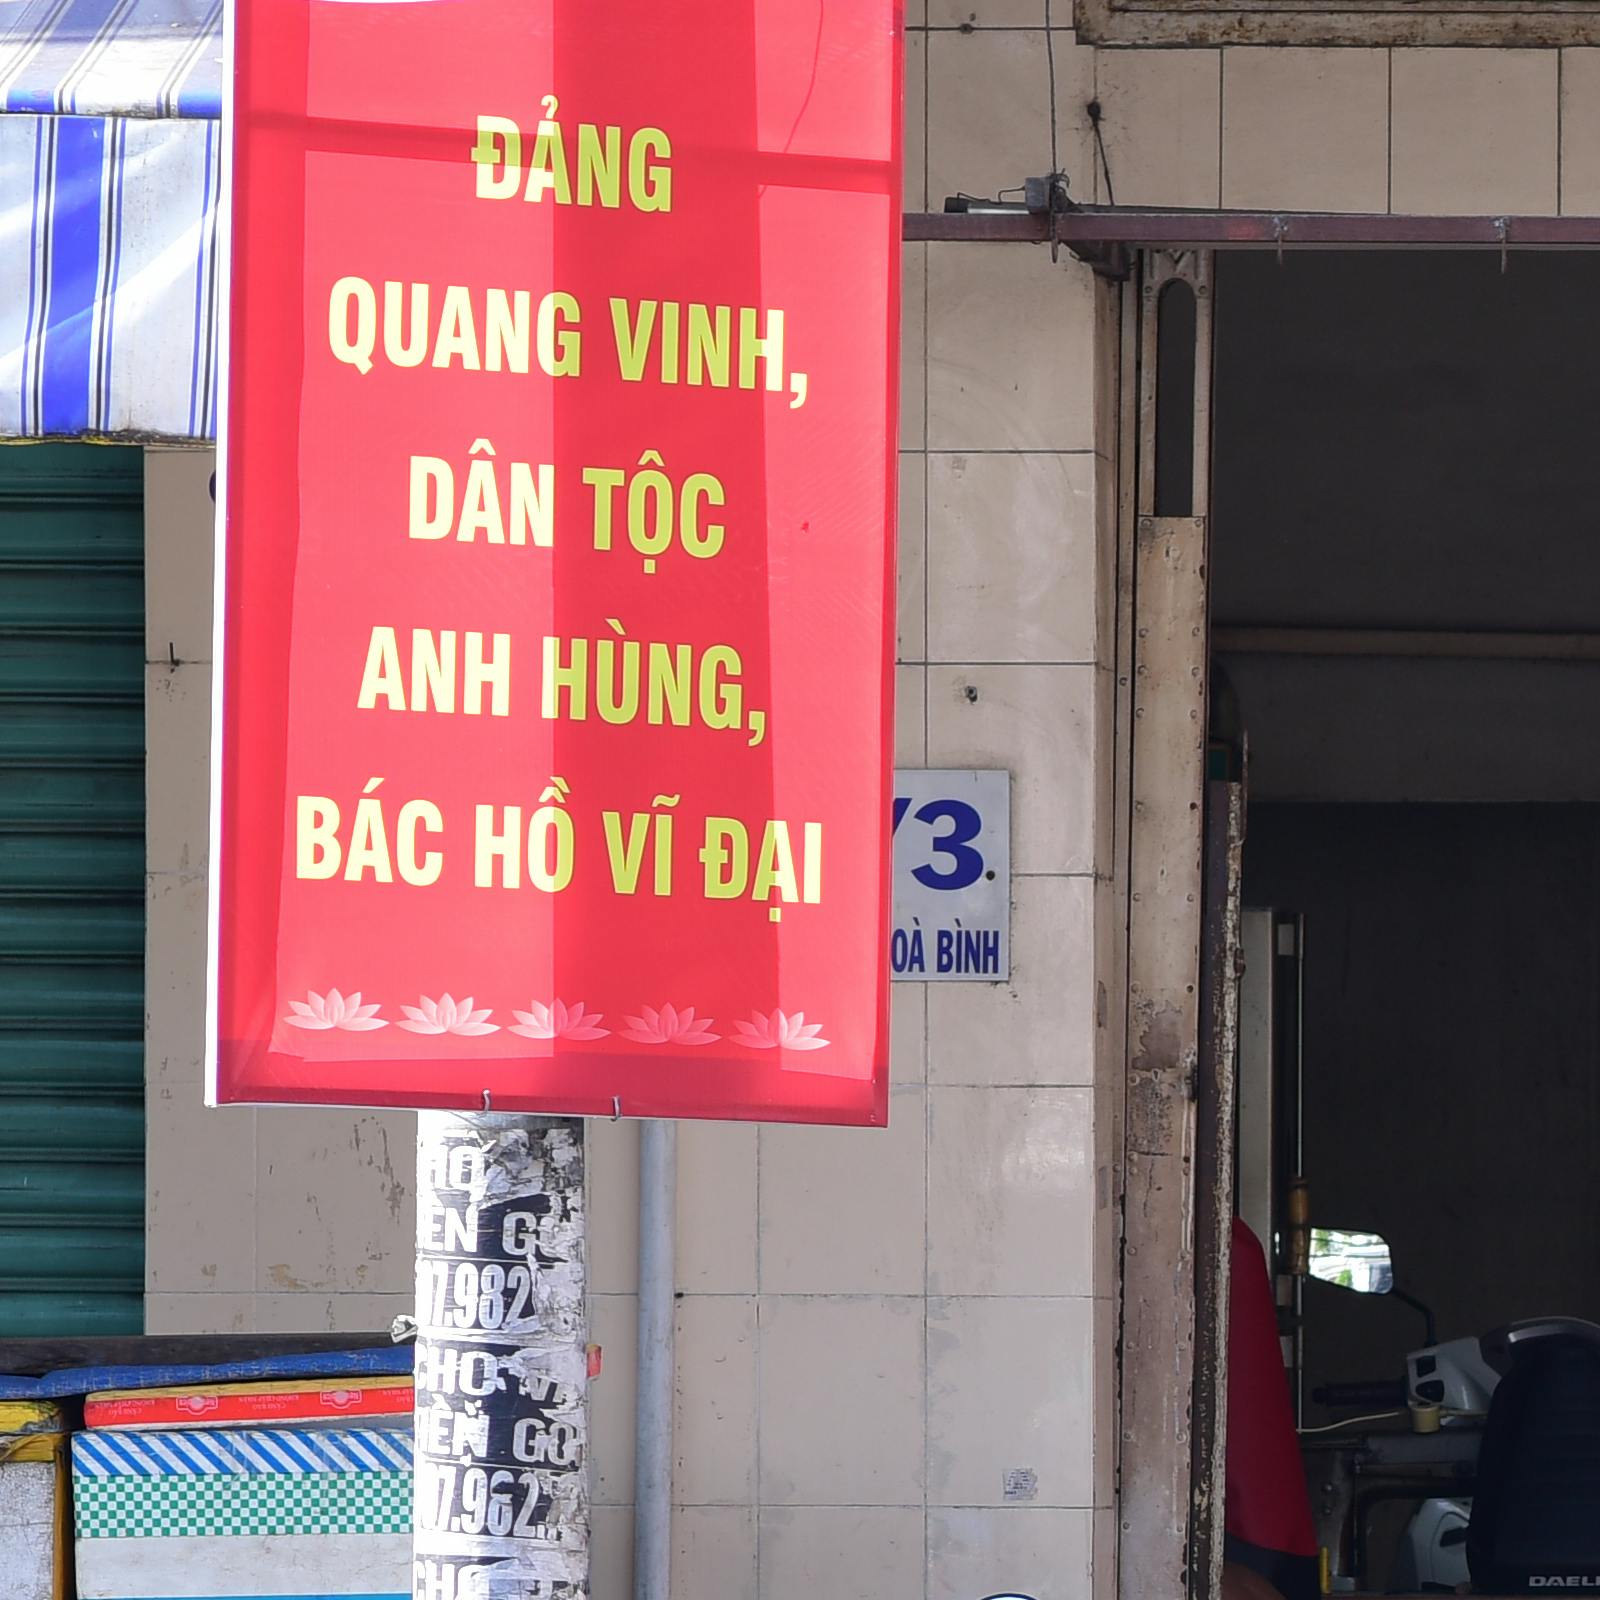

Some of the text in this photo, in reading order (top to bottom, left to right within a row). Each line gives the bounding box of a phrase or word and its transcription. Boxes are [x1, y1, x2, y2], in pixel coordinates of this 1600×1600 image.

[471, 94, 672, 213] ĐẢNG
[328, 276, 809, 410] QUANG VINH,
[409, 437, 727, 574] DÂN TỘC
[356, 618, 767, 747] ANH HÙNG,
[296, 775, 823, 922] BÁC HỒ VĨ ĐẠI
[890, 916, 1000, 975] OÀ BÌNH
